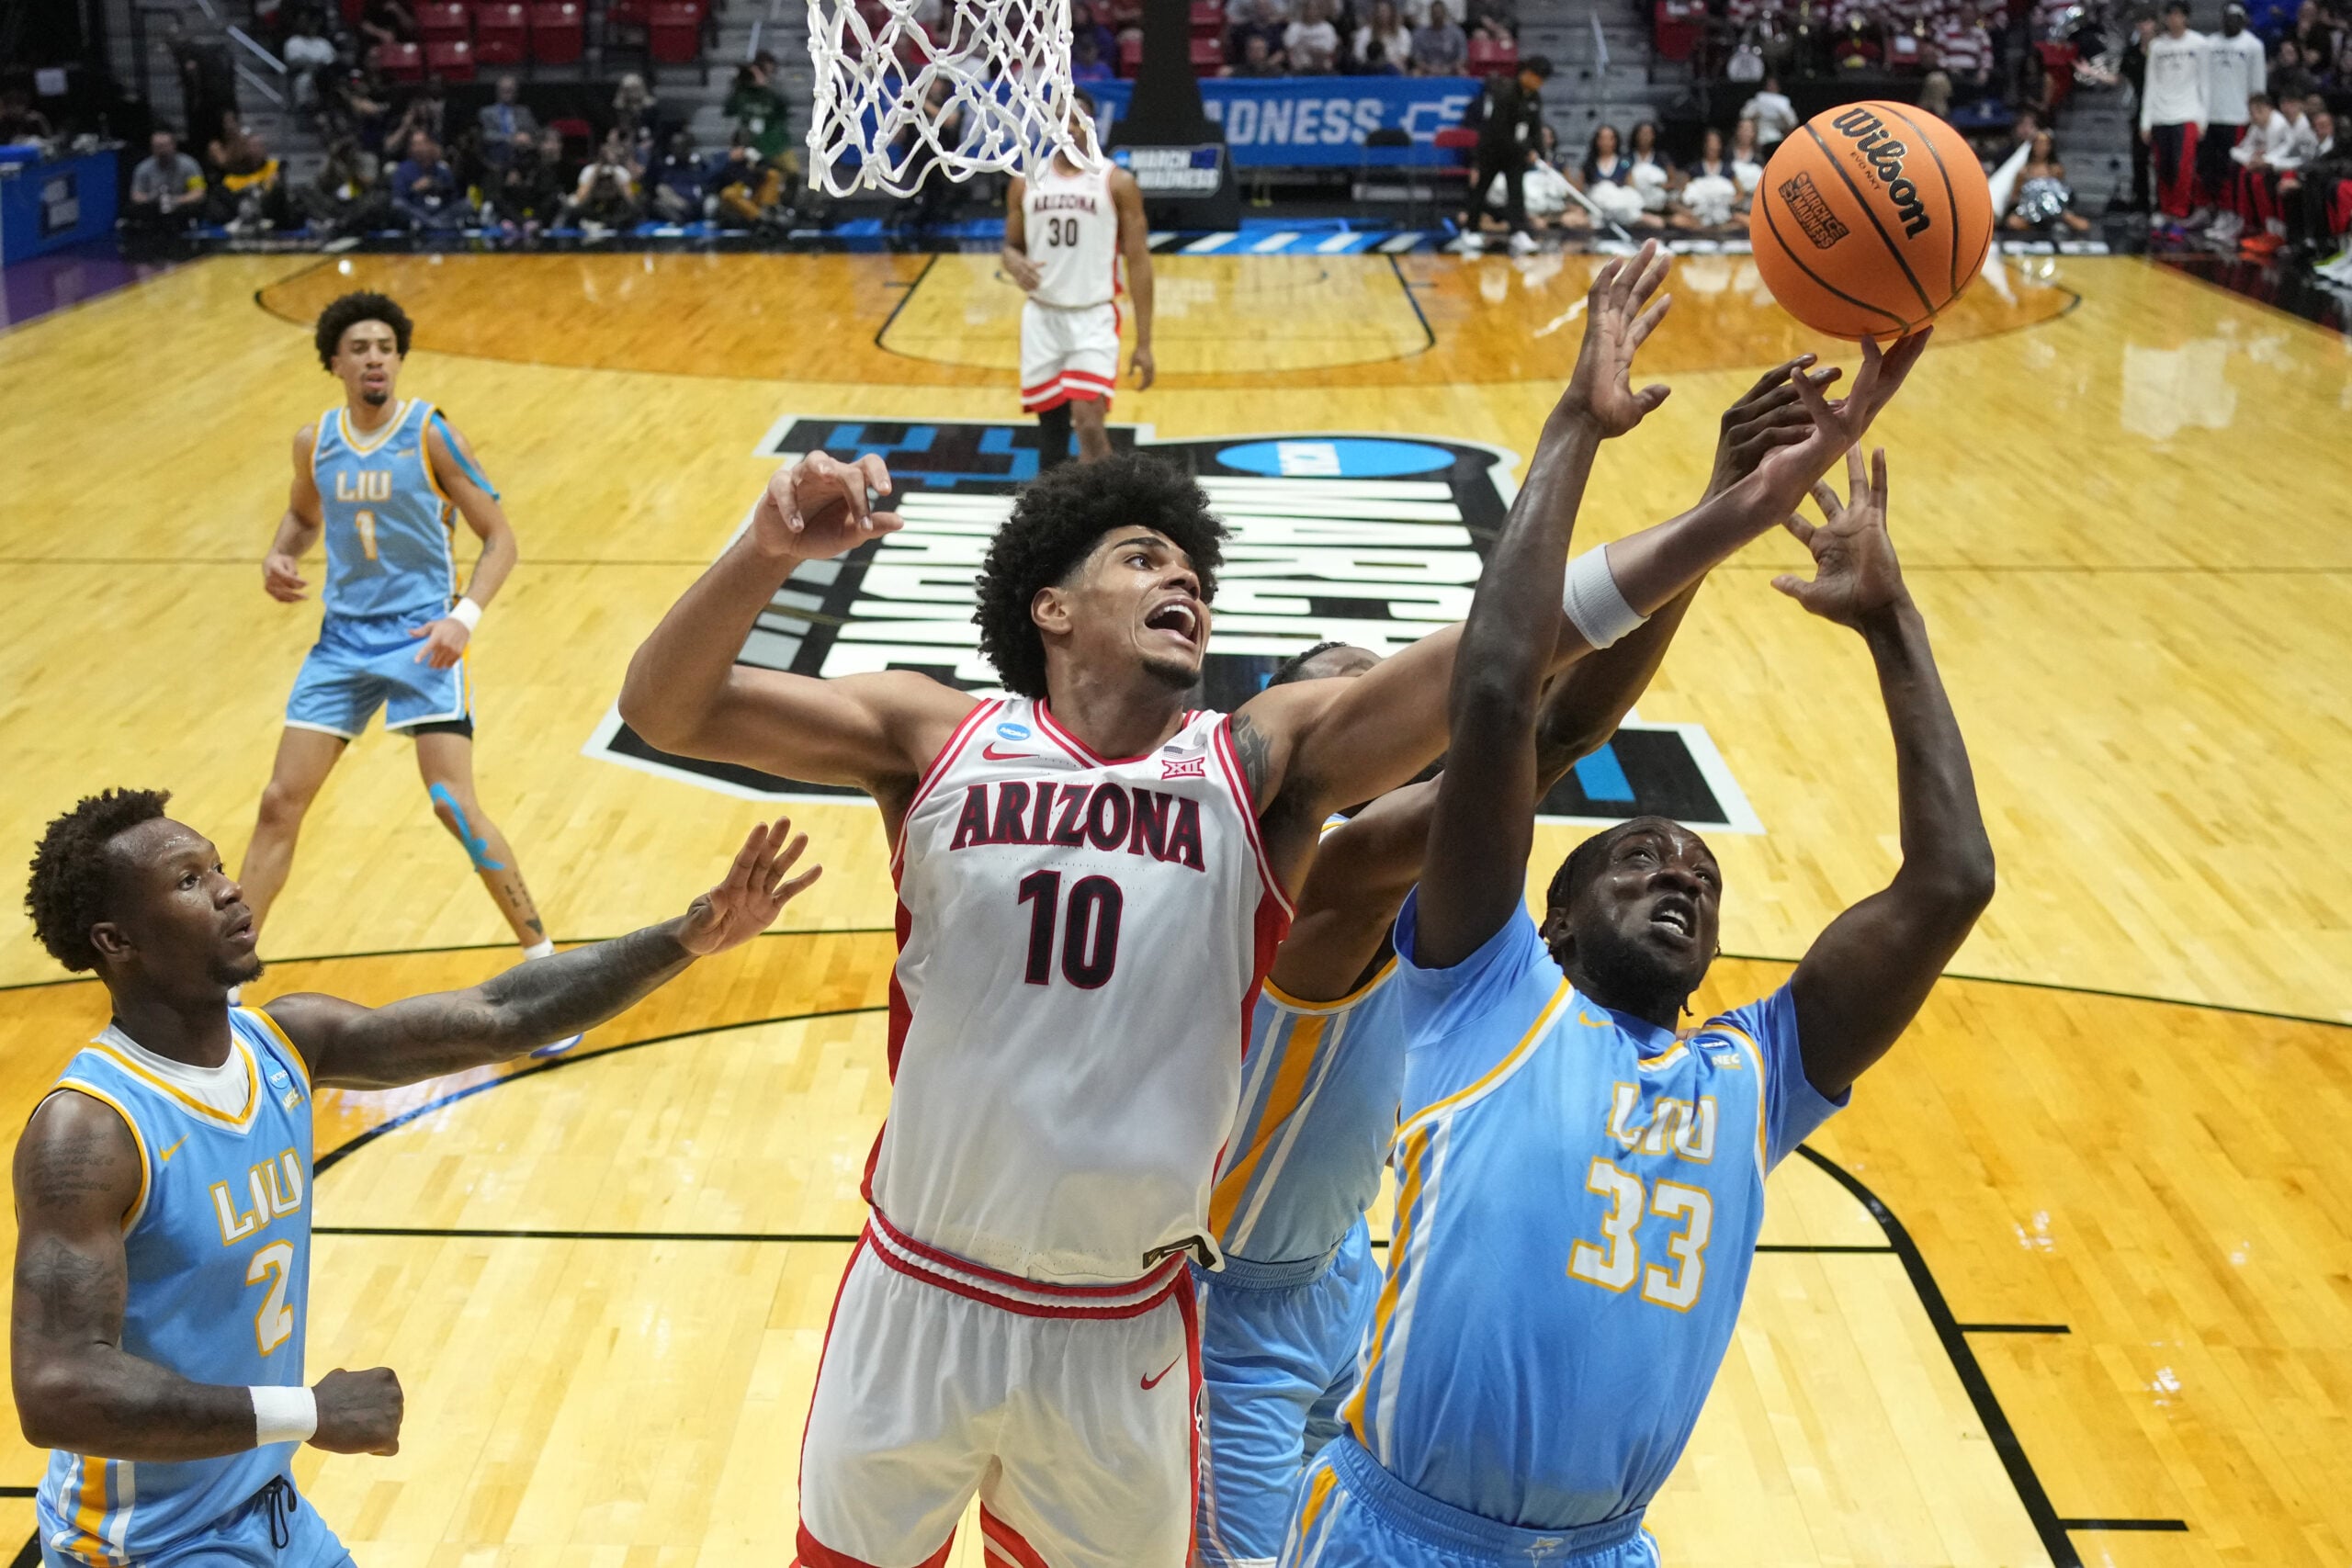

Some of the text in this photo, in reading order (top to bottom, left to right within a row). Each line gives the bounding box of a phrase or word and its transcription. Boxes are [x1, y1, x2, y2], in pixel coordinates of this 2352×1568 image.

[1204, 97, 1385, 146] DNESS
[1798, 181, 1832, 224] MARCH
[1831, 107, 1930, 240] Wilson
[1849, 151, 1881, 191] EVO NXT
[1048, 218, 1079, 248] 30
[1792, 196, 1837, 250] MADNESS
[336, 469, 392, 502] LIU
[355, 508, 378, 560] 1
[950, 782, 1205, 873] ARIZONA
[1017, 869, 1123, 989] 10
[1606, 1082, 1716, 1165] LIU
[209, 1147, 304, 1247] LIU
[1567, 1156, 1714, 1314] 33
[245, 1239, 295, 1357] 2
